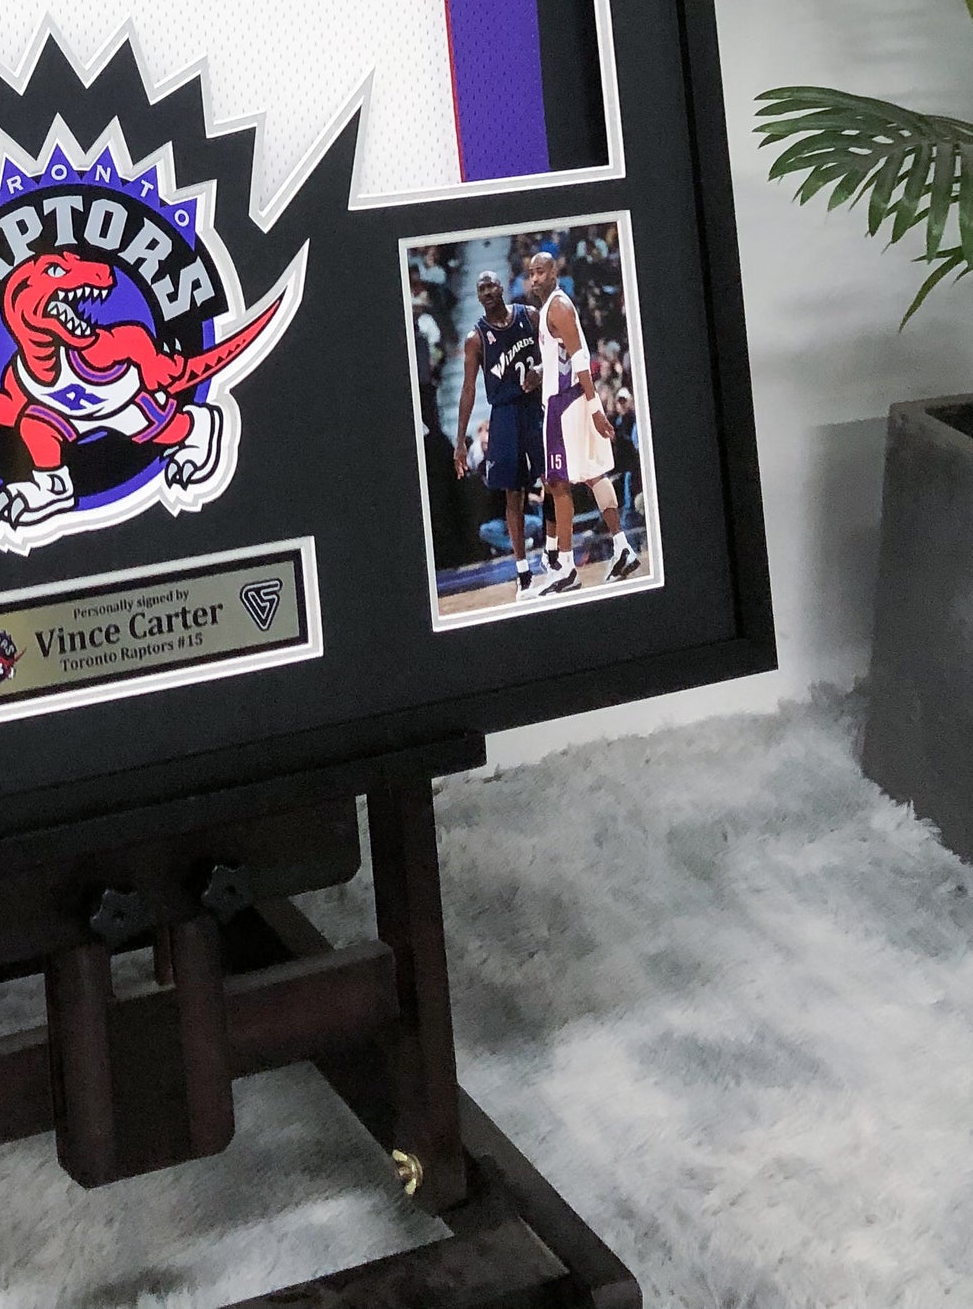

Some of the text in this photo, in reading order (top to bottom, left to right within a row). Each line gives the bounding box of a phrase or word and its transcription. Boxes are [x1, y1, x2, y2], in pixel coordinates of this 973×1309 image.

[550, 454, 562, 470] 15
[74, 588, 190, 620] Personally signed by
[35, 603, 224, 658] Vince Carter
[60, 632, 204, 672] Toronto Raptors #15
